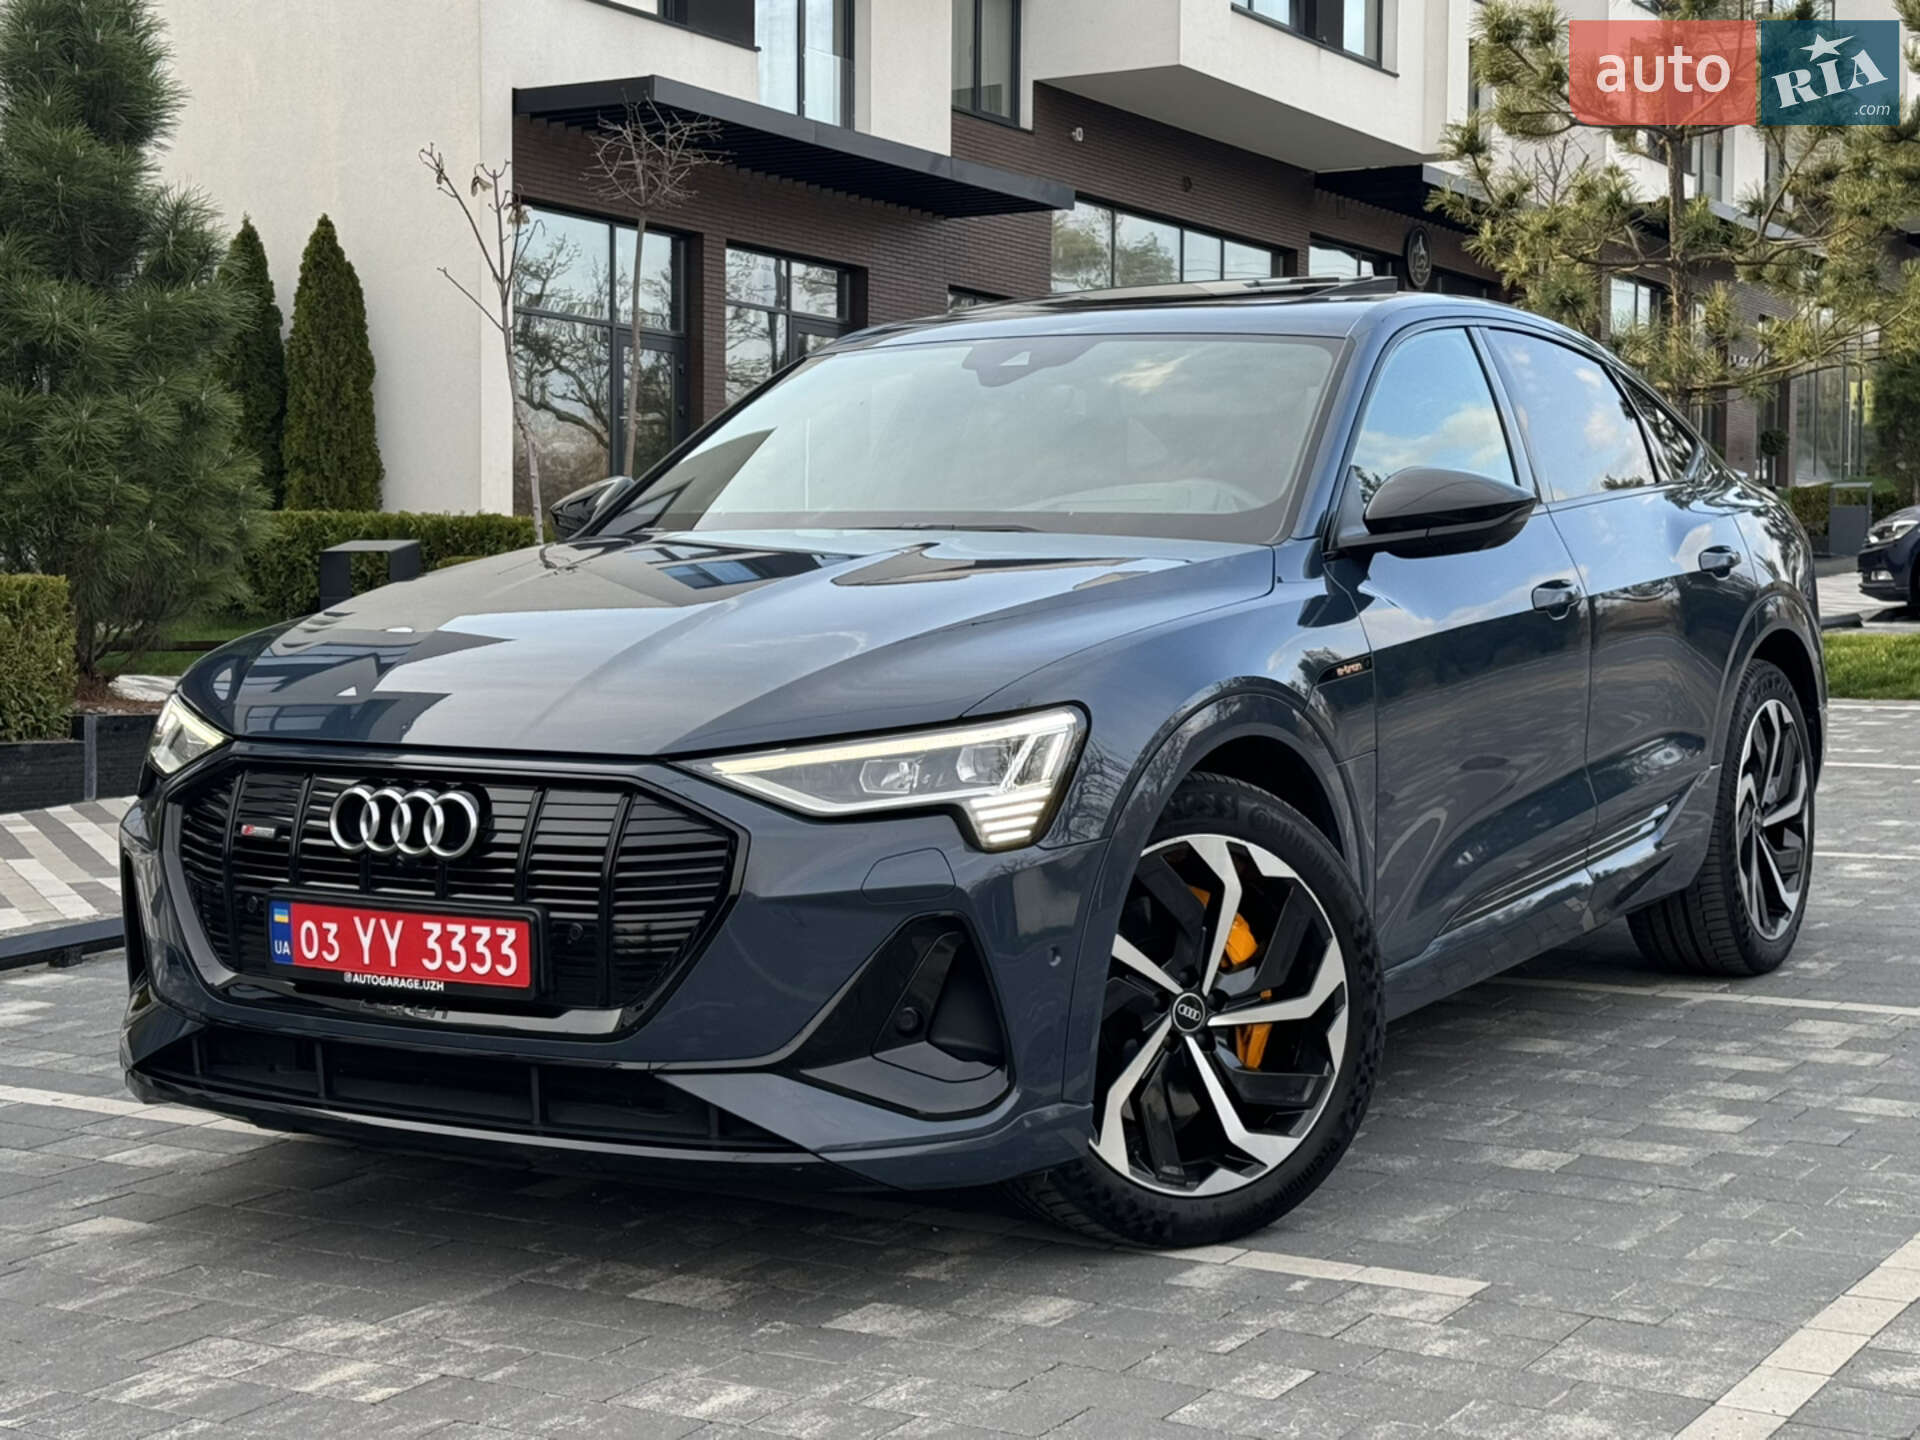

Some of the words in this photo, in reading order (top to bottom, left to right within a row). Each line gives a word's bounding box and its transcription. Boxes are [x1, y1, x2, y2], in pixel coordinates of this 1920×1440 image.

[274, 940, 291, 956] UA
[300, 920, 340, 963] 03
[353, 916, 403, 968] YY
[421, 921, 518, 977] 3333
